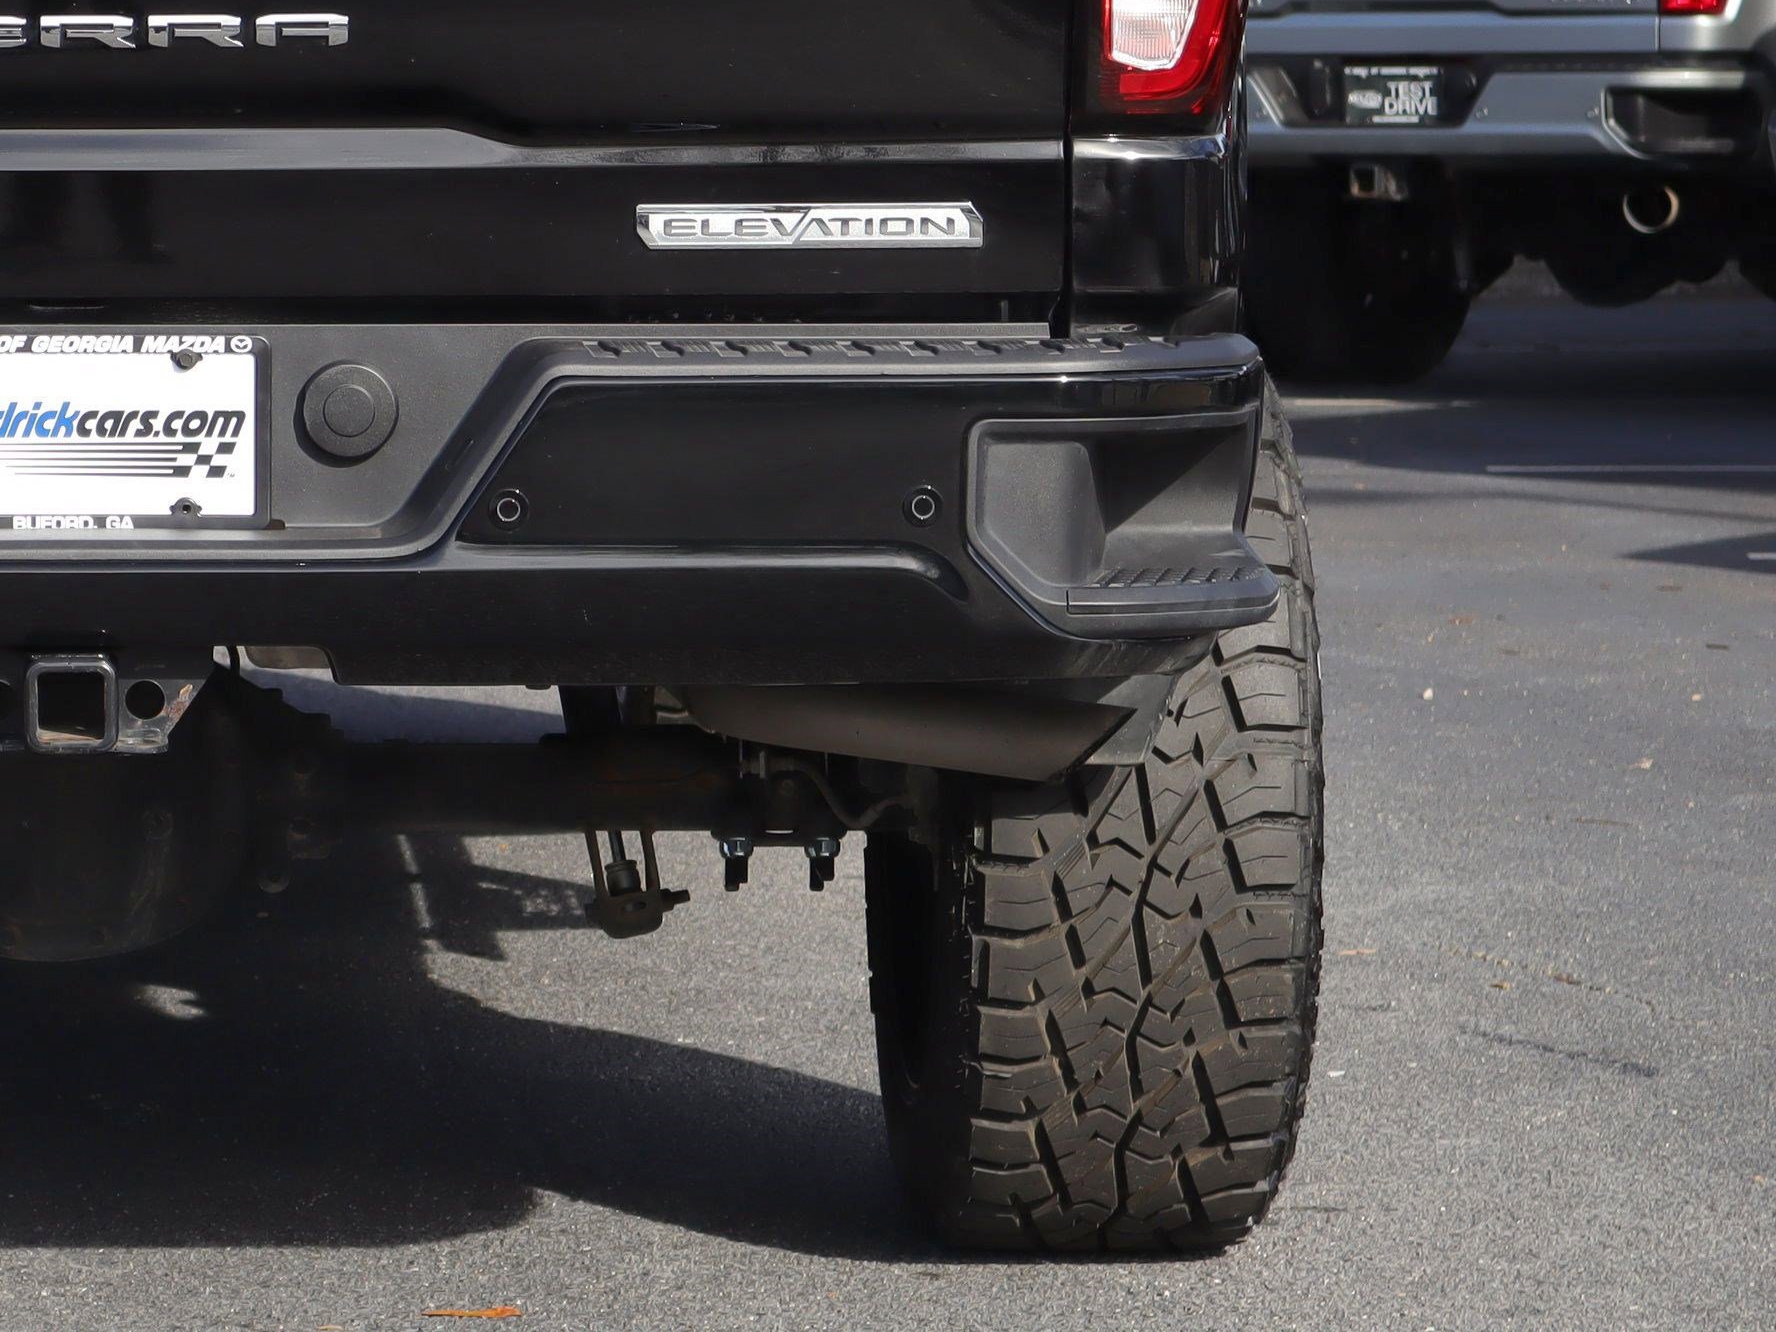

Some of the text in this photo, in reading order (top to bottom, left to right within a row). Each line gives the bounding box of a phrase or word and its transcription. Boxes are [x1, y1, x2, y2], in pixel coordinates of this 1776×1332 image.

[1386, 81, 1433, 99] TEST
[1384, 96, 1438, 116] DRIVE
[662, 216, 957, 238] ELEVATION
[31, 335, 134, 354] GEORGIA
[140, 335, 226, 354] MAZDA
[105, 515, 135, 529] GA
